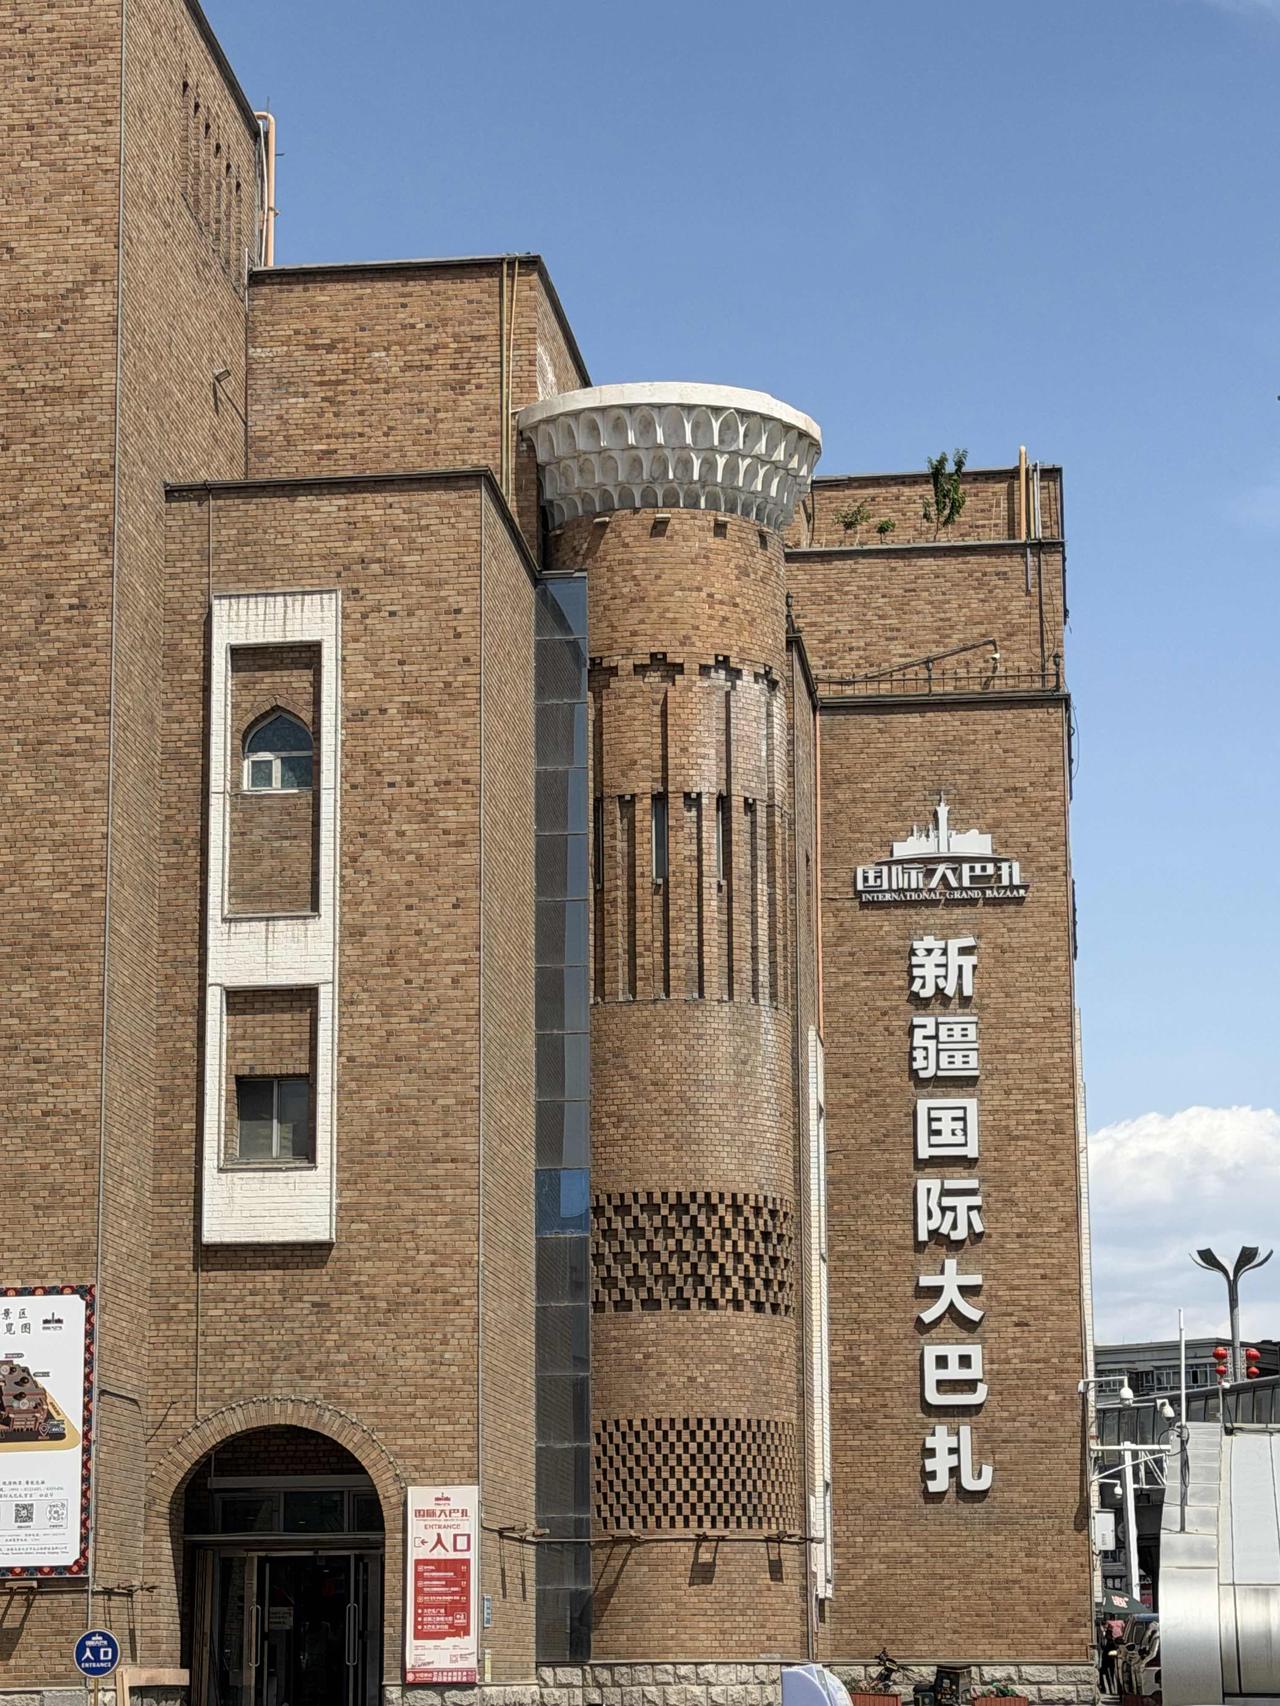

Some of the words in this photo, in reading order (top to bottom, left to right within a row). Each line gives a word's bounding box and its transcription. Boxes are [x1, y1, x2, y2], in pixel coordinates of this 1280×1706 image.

[856, 861, 1022, 891] 国际大巴扎
[862, 891, 944, 902] INTERNATIONAL
[946, 890, 982, 899] GRAND
[985, 889, 1028, 898] BAZAAR
[910, 936, 994, 1493] 新疆国际大巴扎
[414, 1508, 469, 1518] 国际大巴扎
[428, 1532, 471, 1553] 入口
[81, 1647, 112, 1661] 入口
